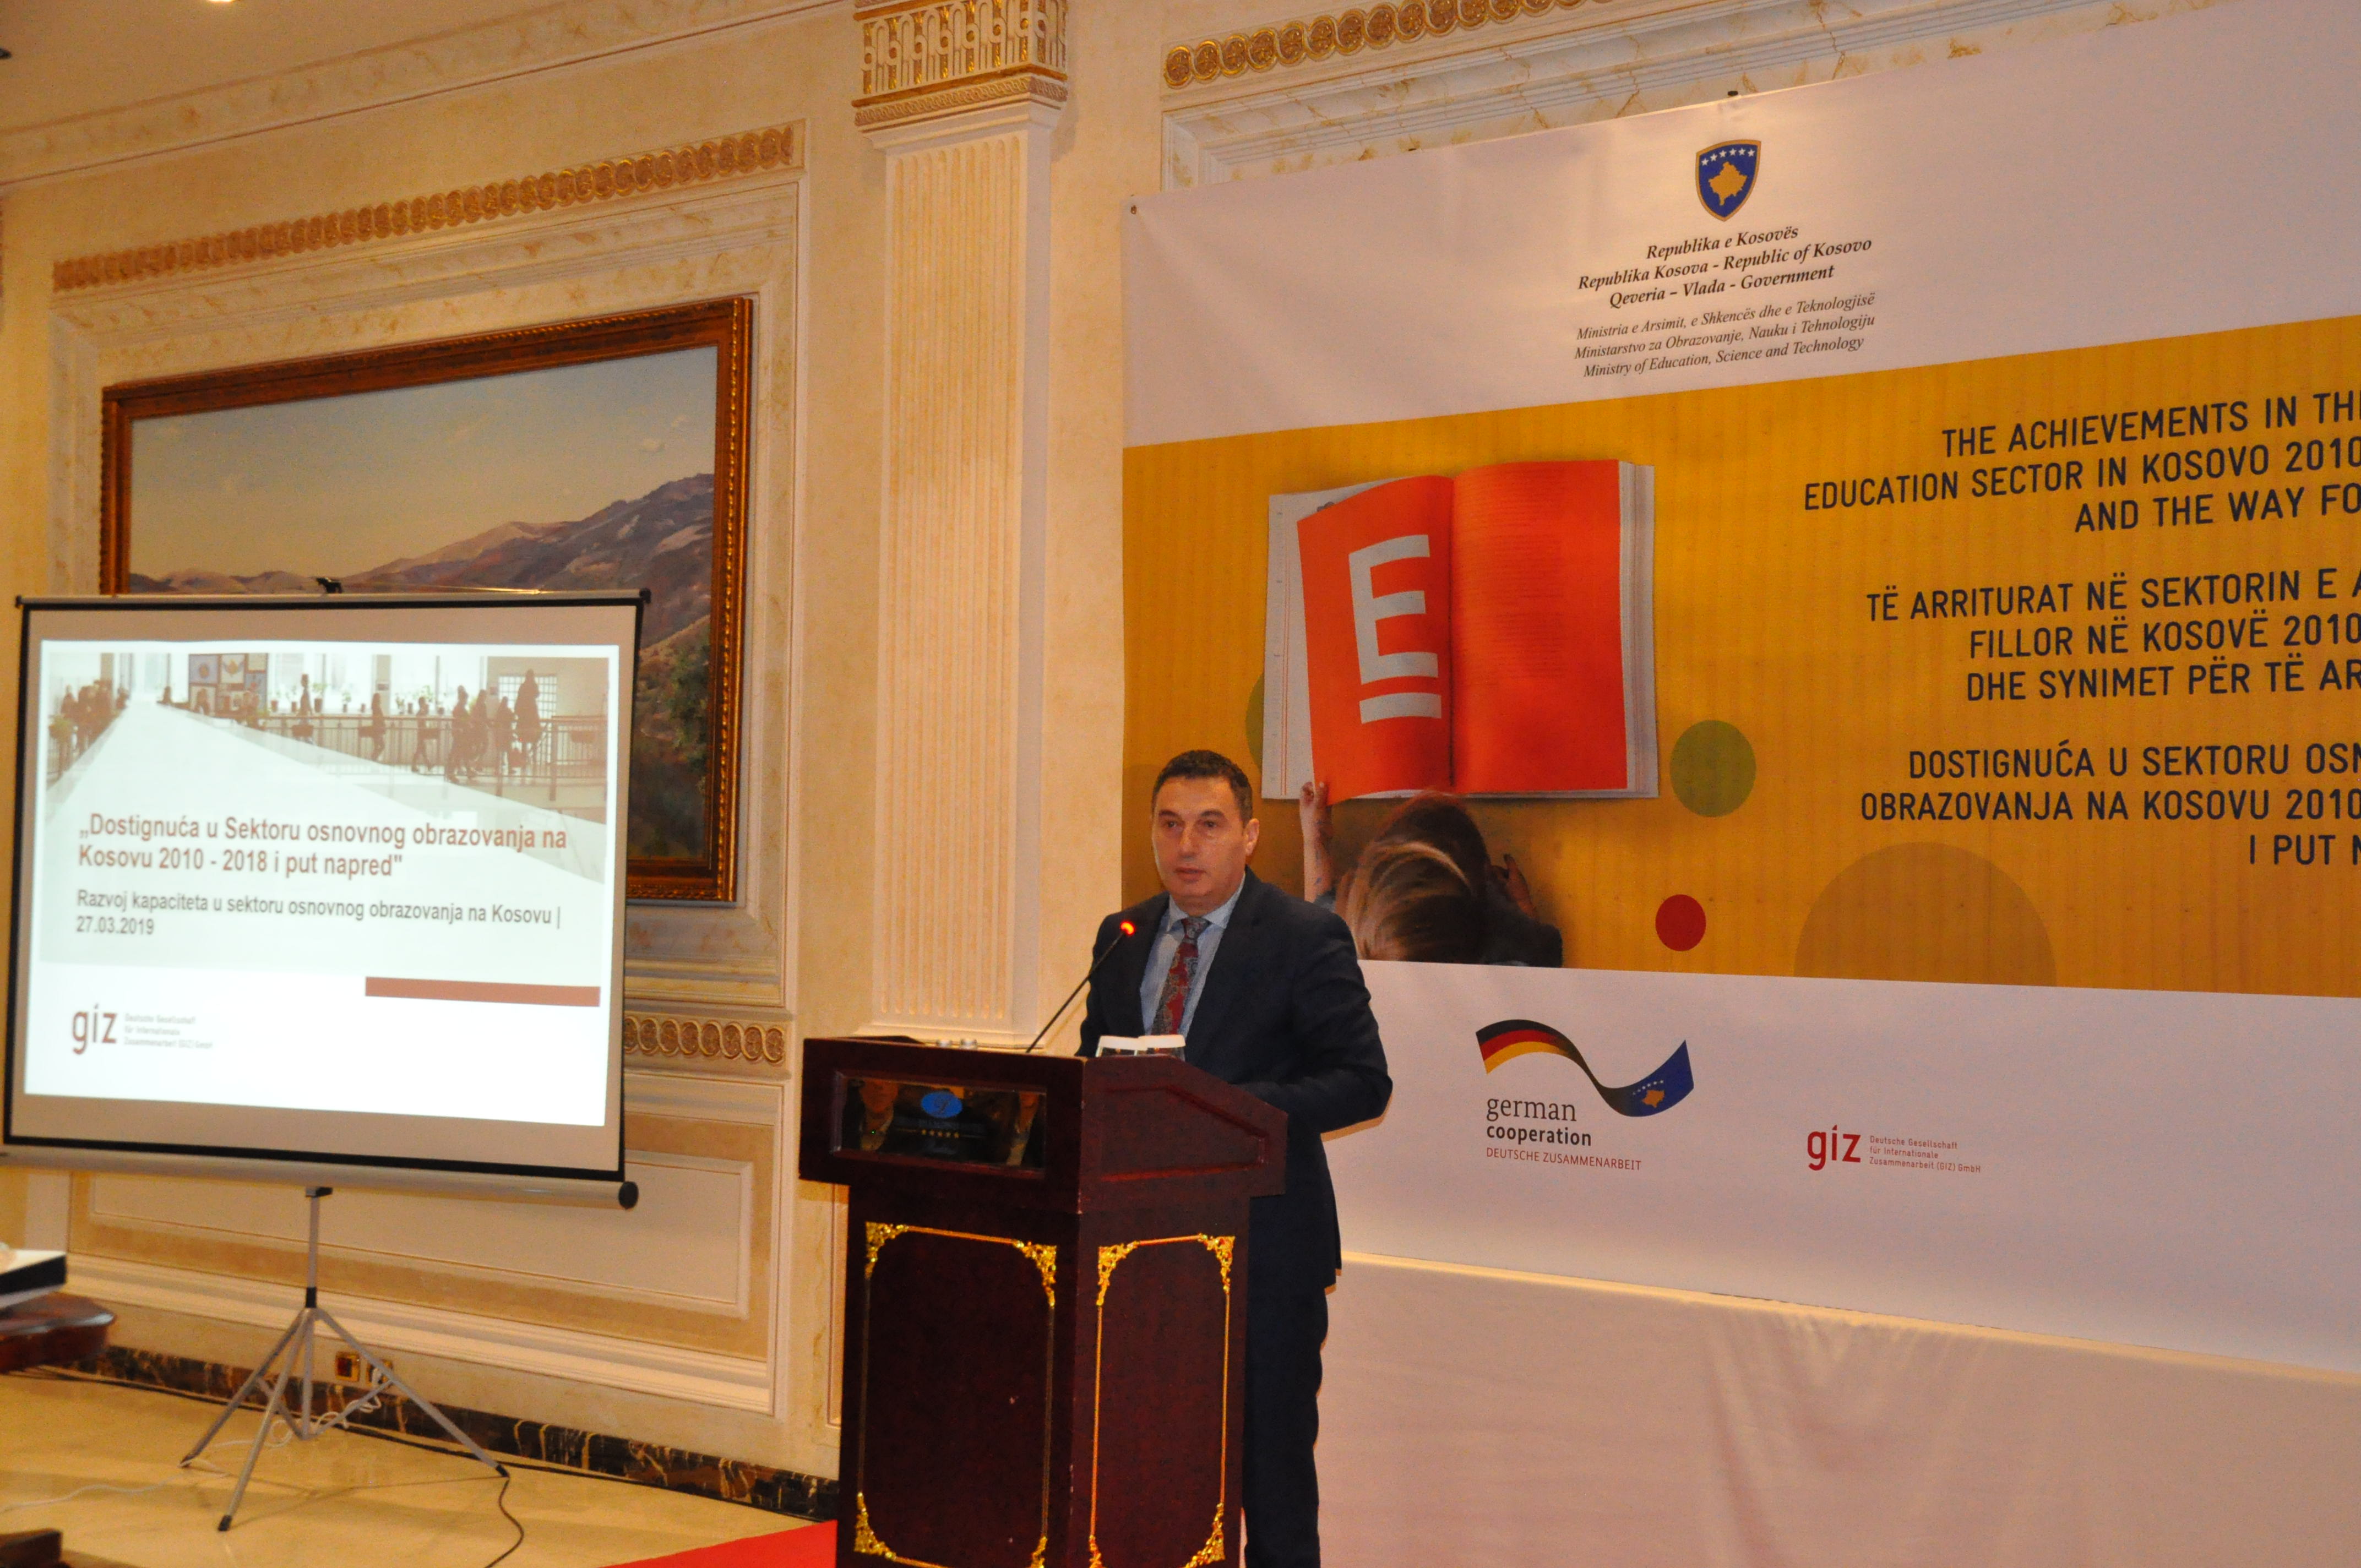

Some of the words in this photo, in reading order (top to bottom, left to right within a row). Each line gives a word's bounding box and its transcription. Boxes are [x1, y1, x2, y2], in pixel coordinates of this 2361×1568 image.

[1647, 237, 1720, 261] Republika
[1724, 238, 1732, 248] e
[1737, 226, 1798, 246] Kosovës
[1579, 268, 1650, 291] Republika
[1654, 263, 1708, 279] Kosova
[1723, 248, 1789, 272] Republic
[1793, 244, 1811, 264] of
[1813, 240, 1872, 258] Kosovo
[1609, 287, 1666, 309] Qeveria
[1683, 279, 1725, 297] Vlada
[1741, 265, 1835, 289] Government
[1577, 324, 1629, 340] Ministria
[1631, 325, 1639, 334] e
[1641, 317, 1687, 333] Arsimit,
[1691, 318, 1698, 326] e
[1701, 308, 1756, 325] Shkencës
[1759, 304, 1782, 318] dhe
[1785, 306, 1792, 315] e
[1797, 292, 1875, 317] Teknologjisë
[1575, 344, 1646, 359] Ministarstvo
[1649, 341, 1662, 351] za
[1666, 330, 1744, 352] Obrazovanje,
[1748, 324, 1788, 339] Nauku
[1792, 323, 1797, 335] i
[1802, 314, 1875, 333] Tehnologiju
[1584, 363, 1631, 377] Ministry
[1634, 358, 1649, 375] of
[1649, 354, 1711, 370] Education,
[1716, 350, 1762, 363] Science
[1765, 342, 1789, 357] and
[1793, 336, 1864, 354] Technology
[1941, 425, 1996, 458] THE
[2008, 401, 2248, 453] ACHIEVEMENTS
[2265, 396, 2297, 429] IN
[2313, 390, 2361, 424] TH
[1804, 471, 1958, 510] EDUCATION
[1972, 460, 2083, 497] SECTOR
[2098, 456, 2126, 488] IN
[2143, 444, 2269, 484] KOSOVO
[2285, 435, 2361, 472] 2010
[2075, 500, 2139, 533] AND
[2152, 493, 2214, 527] THE
[2228, 486, 2305, 522] WAY
[2321, 482, 2361, 516] FO
[1348, 534, 1439, 685] E
[1866, 585, 1898, 622] TË
[1910, 583, 2074, 620] ARRITURAT
[2087, 571, 2128, 611] NË
[2141, 570, 2299, 608] SEKTORIN
[2318, 568, 2337, 599] E
[1970, 627, 2073, 659] FILLOR
[2088, 615, 2129, 655] NË
[2143, 608, 2268, 652] KOSOVË
[2283, 612, 2361, 646] 2010
[1967, 671, 2026, 701] DHE
[2039, 666, 2174, 699] SYNIMET
[2188, 655, 2250, 695] PËR
[2264, 652, 2304, 692] TË
[1909, 739, 2095, 779] DOSTIGNUĆA
[2109, 747, 2127, 777] U
[2143, 744, 2289, 776] SEKTORU
[1861, 791, 2074, 820] OBRAZOVANJA
[2087, 791, 2129, 820] NA
[2144, 790, 2269, 820] KOSOVU
[2286, 788, 2361, 820] 2010
[207, 823, 217, 838] u
[225, 816, 300, 840] Sektoru
[307, 824, 405, 850] osnovnog
[413, 823, 536, 853] obrazovanja
[542, 831, 567, 848] na
[2250, 835, 2255, 865] I
[2273, 834, 2336, 865] PUT
[79, 845, 152, 868] Kosovu
[159, 847, 203, 870] 2010
[222, 849, 267, 872] 2018
[274, 851, 279, 873] i
[286, 853, 317, 878] put
[76, 916, 154, 935] 27.03.2019
[77, 889, 127, 912] Razvoj
[132, 892, 208, 913] kapaciteta
[213, 898, 222, 912] u
[227, 896, 283, 914] sektoru
[289, 901, 364, 921] osnovnog
[369, 900, 463, 924] obrazovanja
[469, 907, 486, 921] na
[492, 905, 551, 924] Kosovu
[72, 1003, 117, 1055] giz
[1486, 1098, 1577, 1122] german
[1487, 1125, 1591, 1146] cooperation
[1807, 1125, 1861, 1171] giz
[1870, 1135, 1905, 1146] Deutsche
[1908, 1138, 1957, 1149] Gesellschaft
[1870, 1146, 1881, 1154] für
[1884, 1147, 1939, 1159] Internationale
[1487, 1147, 1539, 1162] DEUTSCHE
[1543, 1152, 1641, 1170] ZUSAMMENARBEIT
[1869, 1156, 1934, 1169] Zusammenarbeit
[1936, 1161, 1956, 1172] (GIZ)
[1958, 1163, 1981, 1173] GmbH
